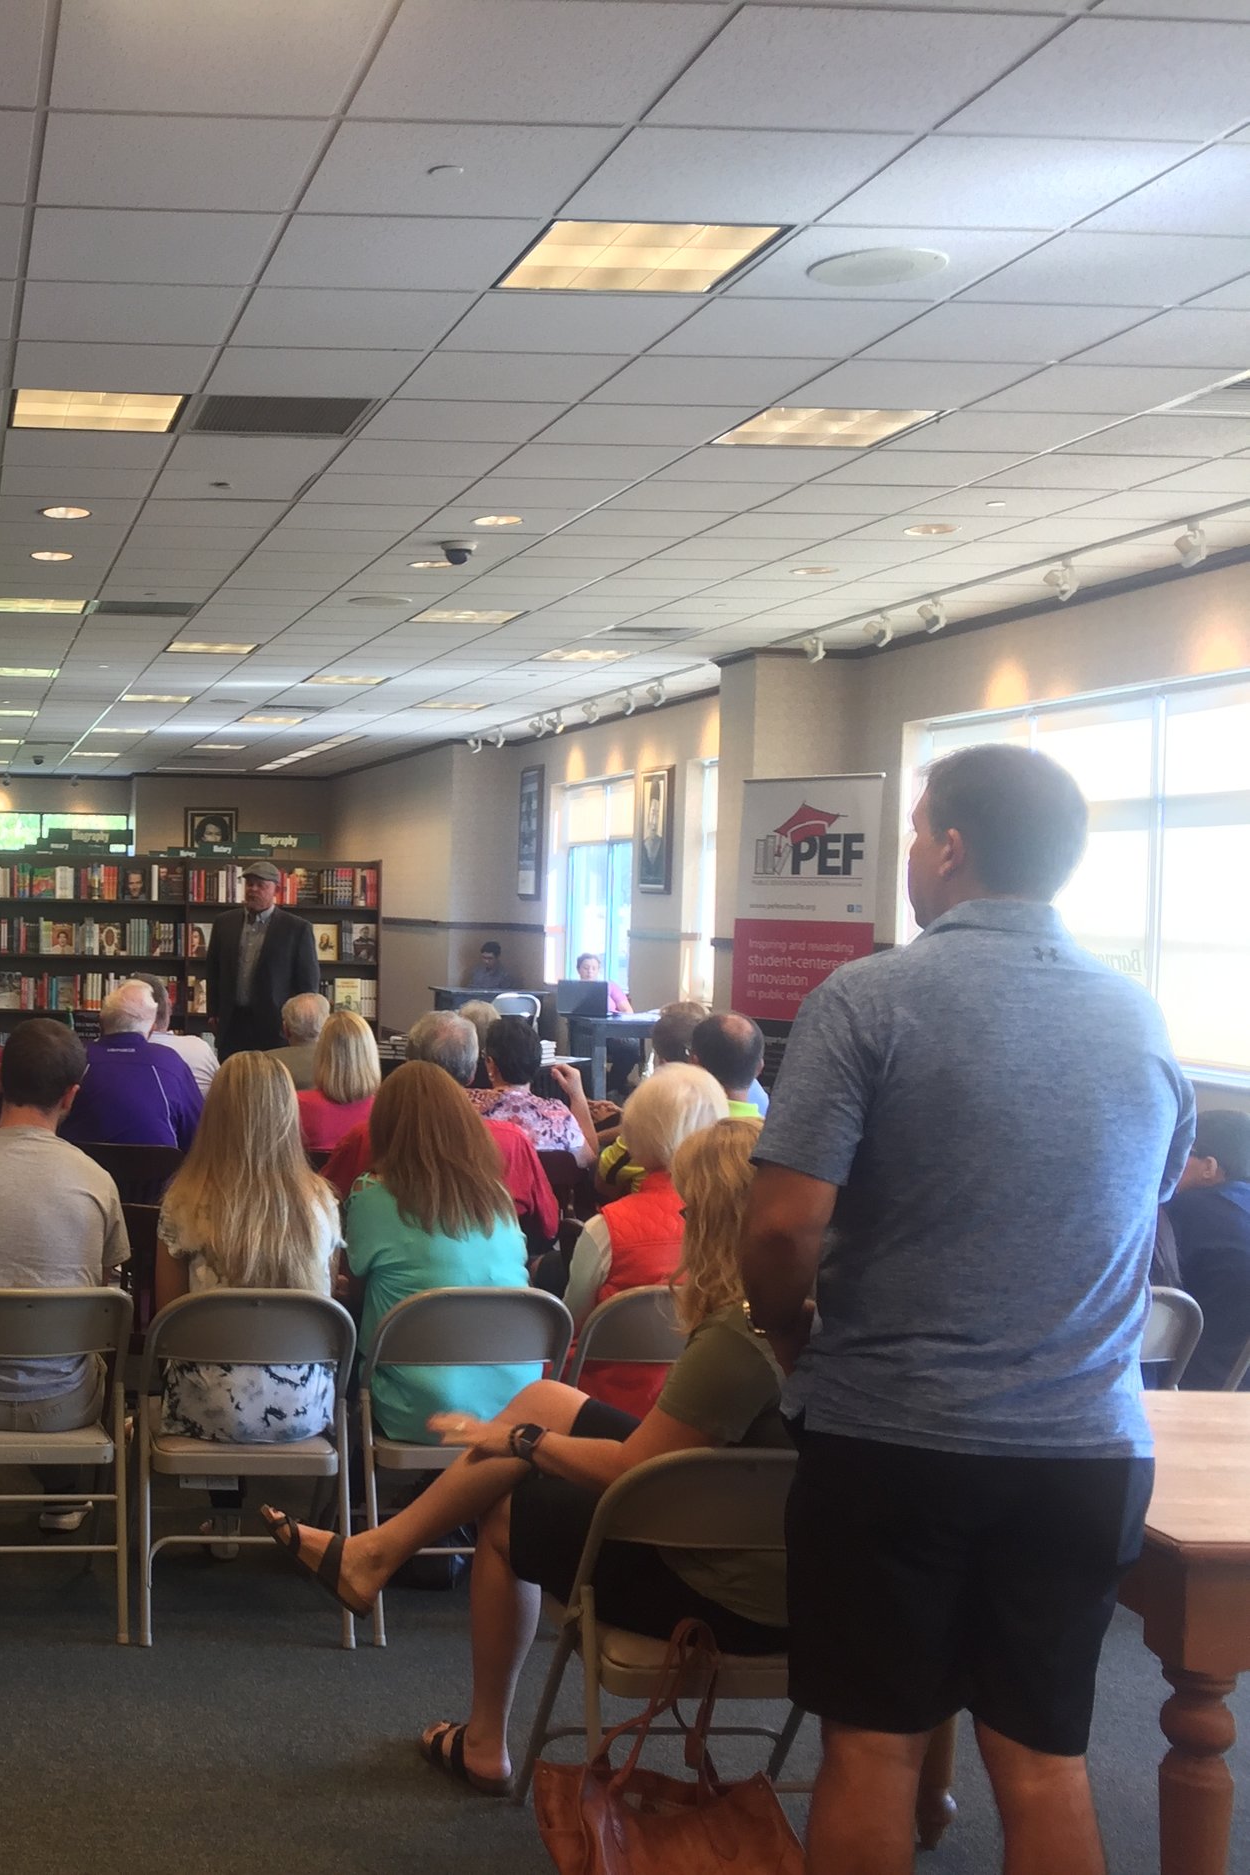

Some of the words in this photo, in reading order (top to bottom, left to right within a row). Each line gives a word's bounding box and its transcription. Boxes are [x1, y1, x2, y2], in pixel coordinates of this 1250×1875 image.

[72, 830, 110, 844] Biography
[259, 834, 298, 848] Biography
[791, 833, 865, 876] PEF
[749, 938, 787, 953] Inspiring
[789, 940, 806, 951] and
[807, 942, 855, 957] rewarding
[747, 969, 808, 986] innovation
[746, 989, 756, 998] in
[758, 989, 785, 1001] public
